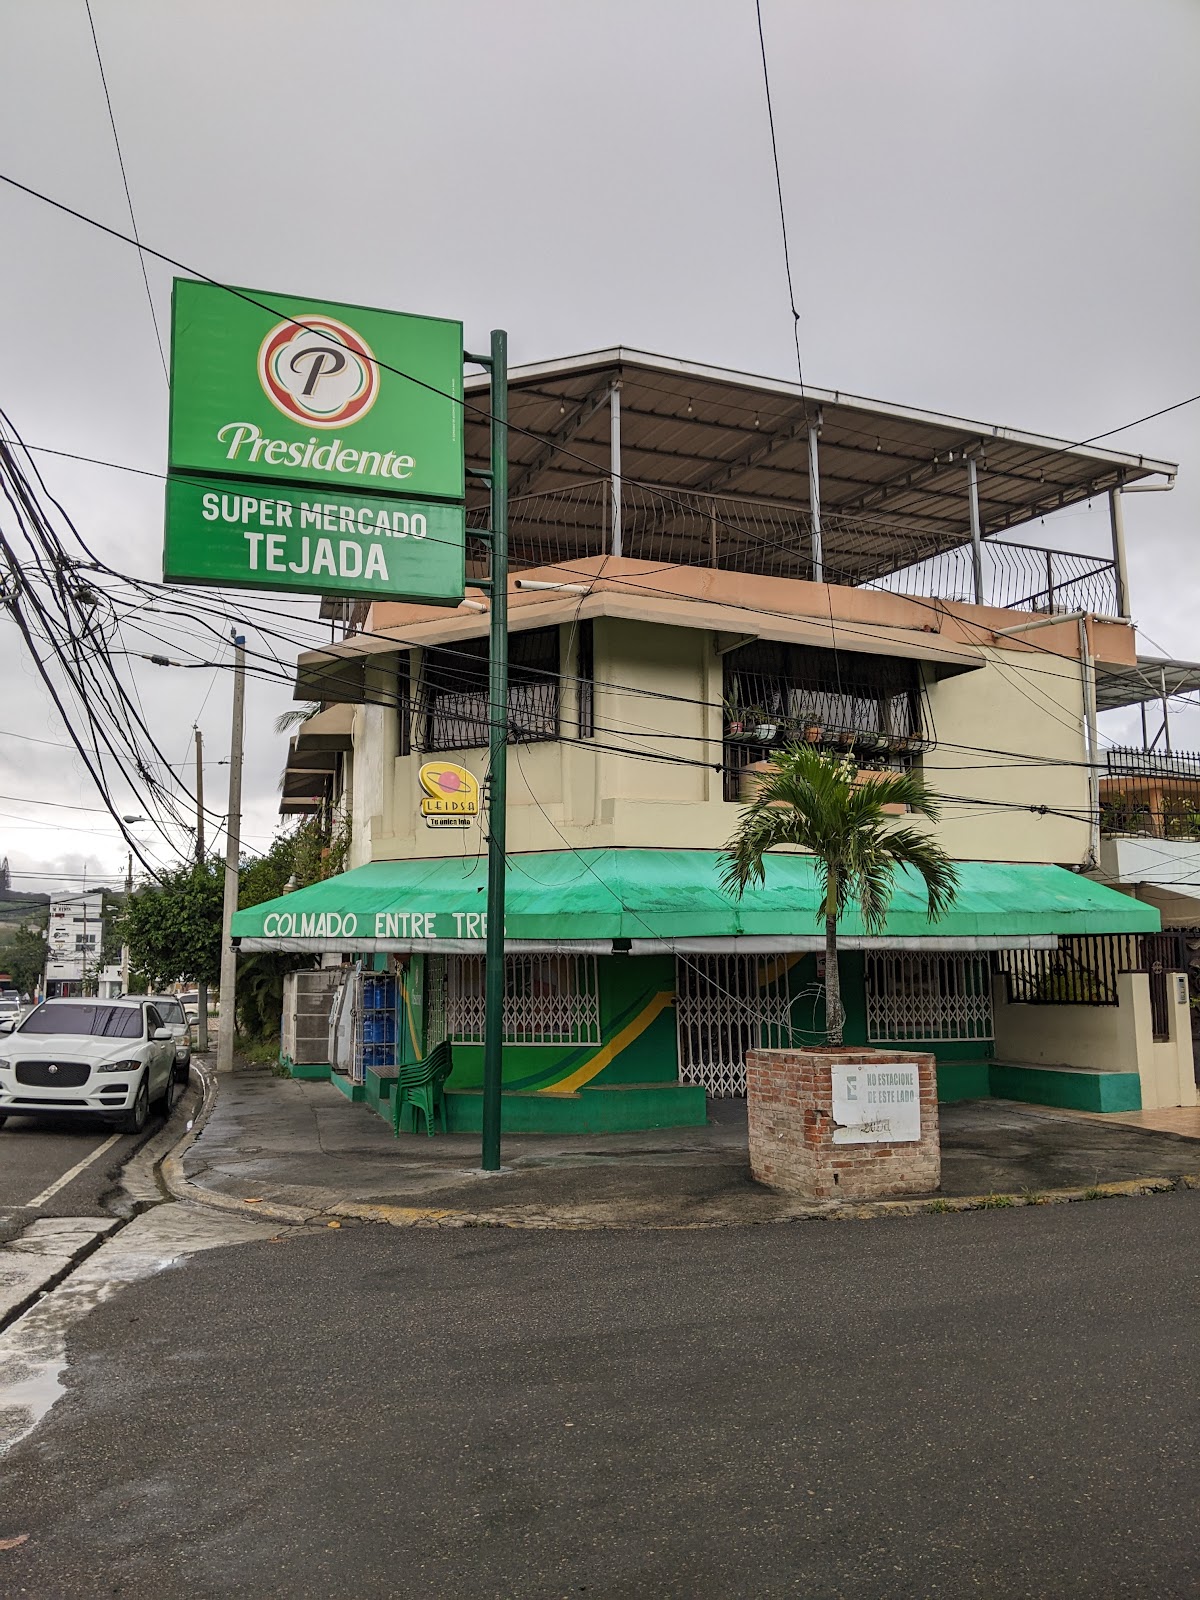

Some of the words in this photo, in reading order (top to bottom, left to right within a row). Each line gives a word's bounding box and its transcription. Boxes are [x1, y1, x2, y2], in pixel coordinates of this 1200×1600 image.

[290, 347, 346, 398] P
[217, 422, 416, 479] Presidente
[202, 493, 293, 528] SUPER
[301, 502, 427, 540] MERCADO
[244, 532, 389, 581] TEJADA
[427, 801, 475, 811] LEIDSA
[263, 913, 358, 938] COLMADO
[375, 913, 437, 938] ENTRE
[452, 912, 507, 939] TRE
[866, 1073, 877, 1086] NO
[878, 1073, 914, 1086] ESTACIONE
[867, 1091, 877, 1104] DE
[878, 1090, 895, 1104] ESTE
[896, 1089, 915, 1103] LADO
